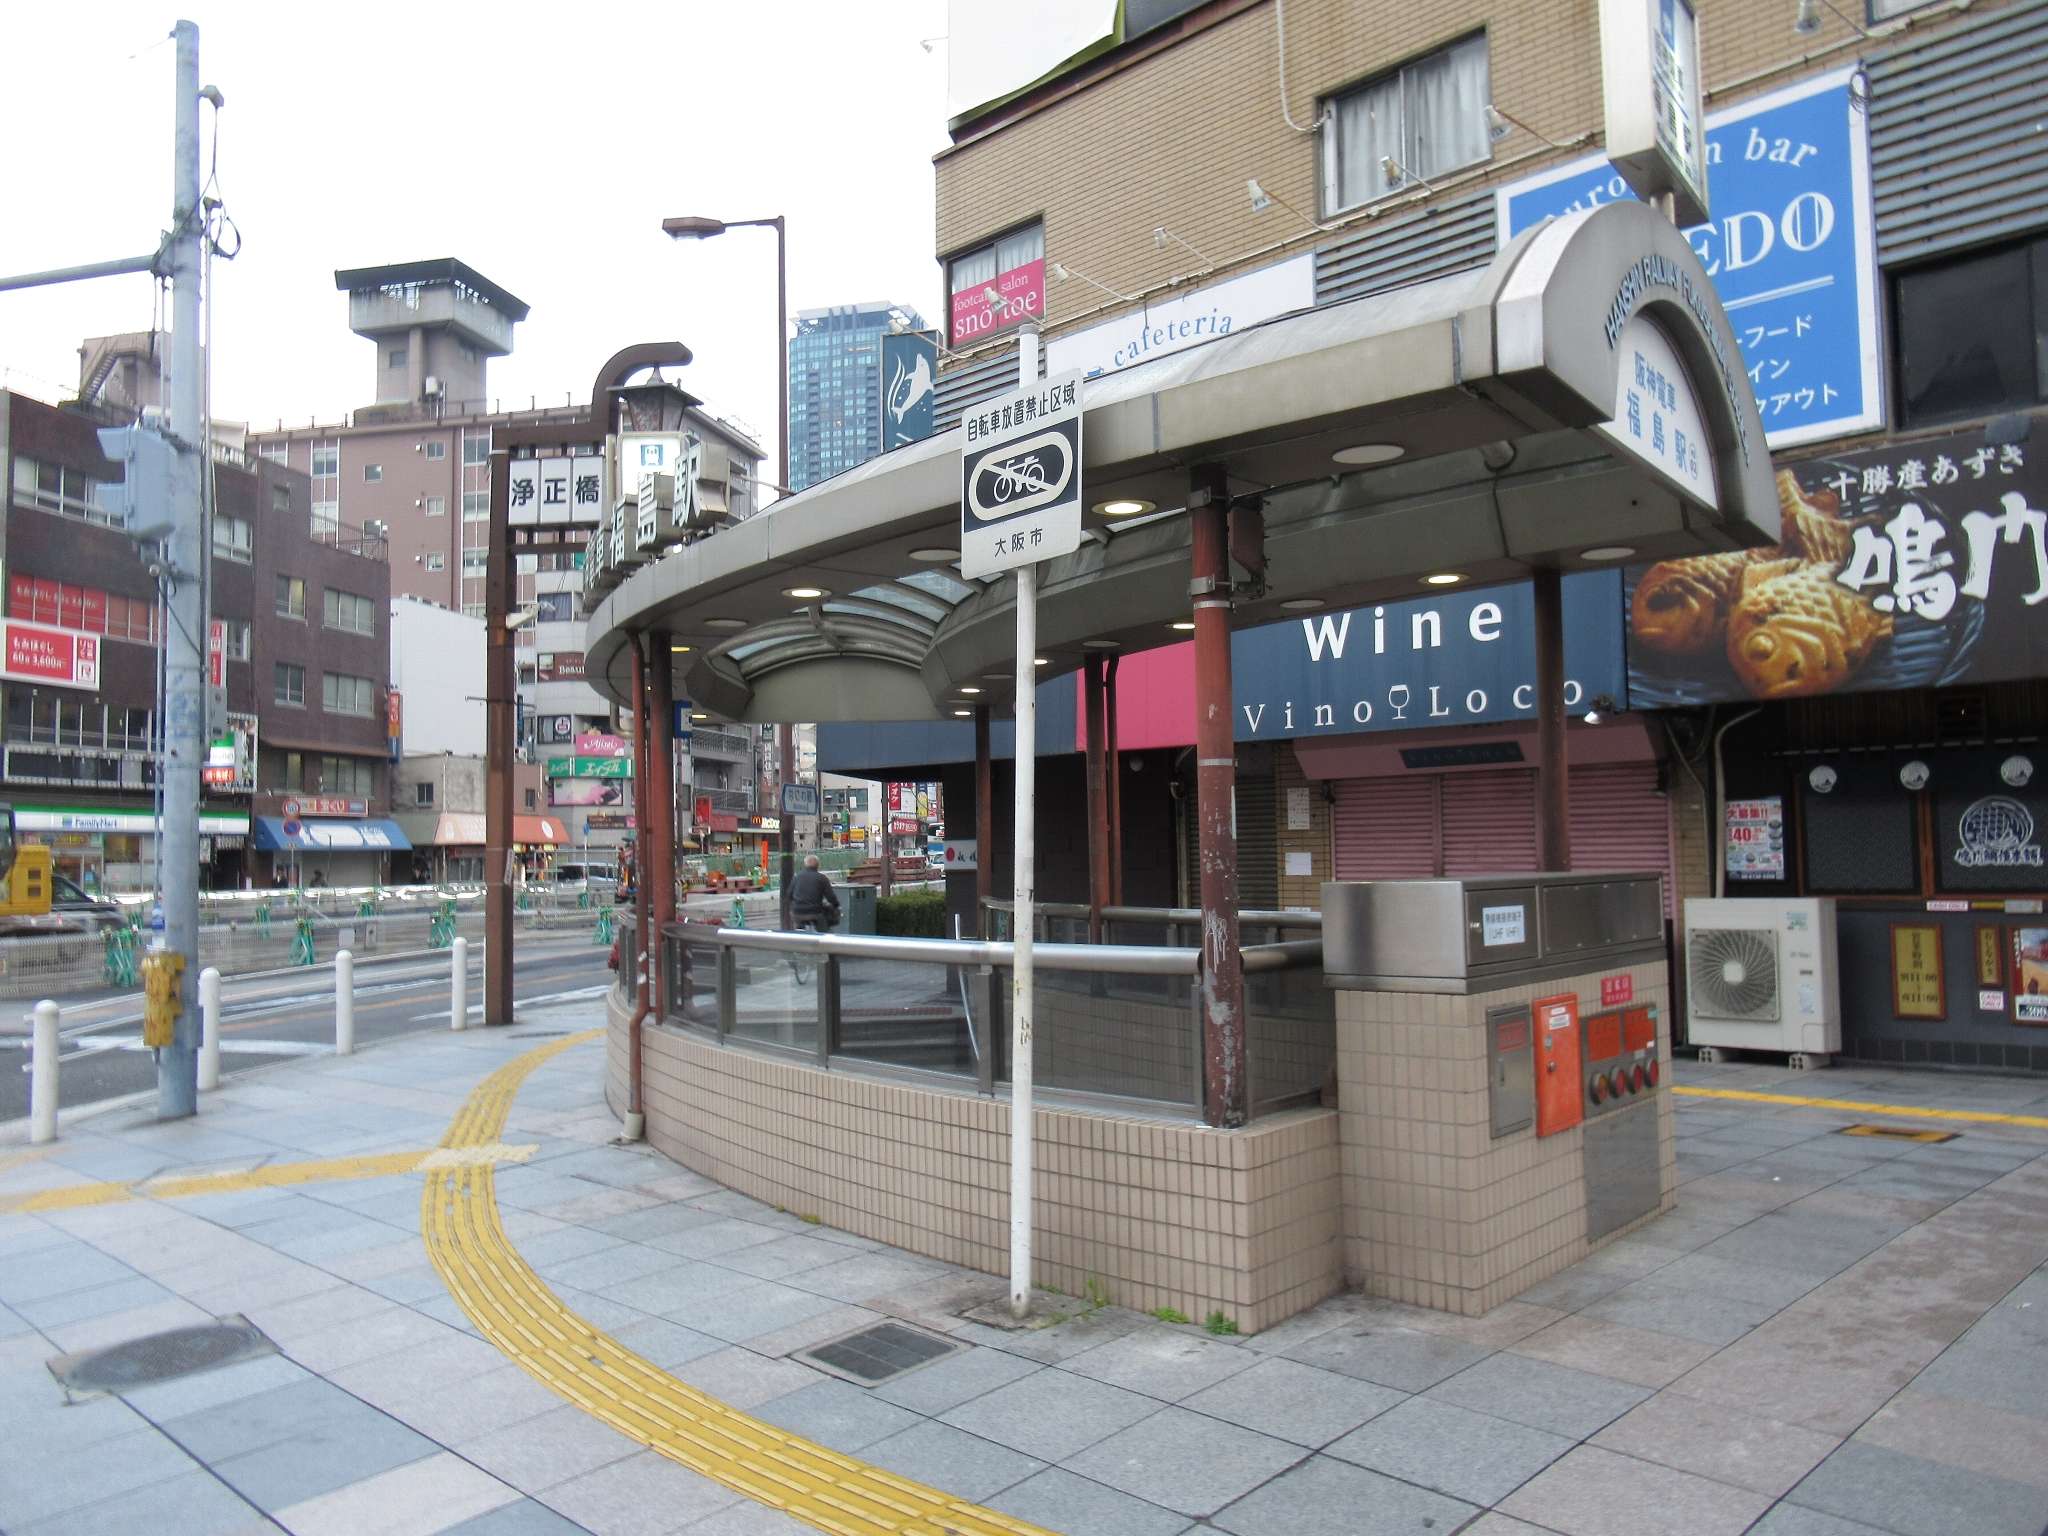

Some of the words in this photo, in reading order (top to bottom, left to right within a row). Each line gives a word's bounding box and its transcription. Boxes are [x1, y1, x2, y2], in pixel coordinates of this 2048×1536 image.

[1745, 128, 1817, 168] bar
[1001, 275, 1029, 293] salon
[1113, 308, 1232, 367] cafeteria
[967, 380, 1076, 442] 自転車放置禁止区域
[511, 475, 600, 506] 浄正橋
[1829, 443, 2024, 501] 十勝産あずき
[994, 528, 1043, 558] 大阪市
[1302, 601, 1502, 662] Wine
[1243, 700, 1373, 733] Vino
[1428, 679, 1583, 718] Loco
